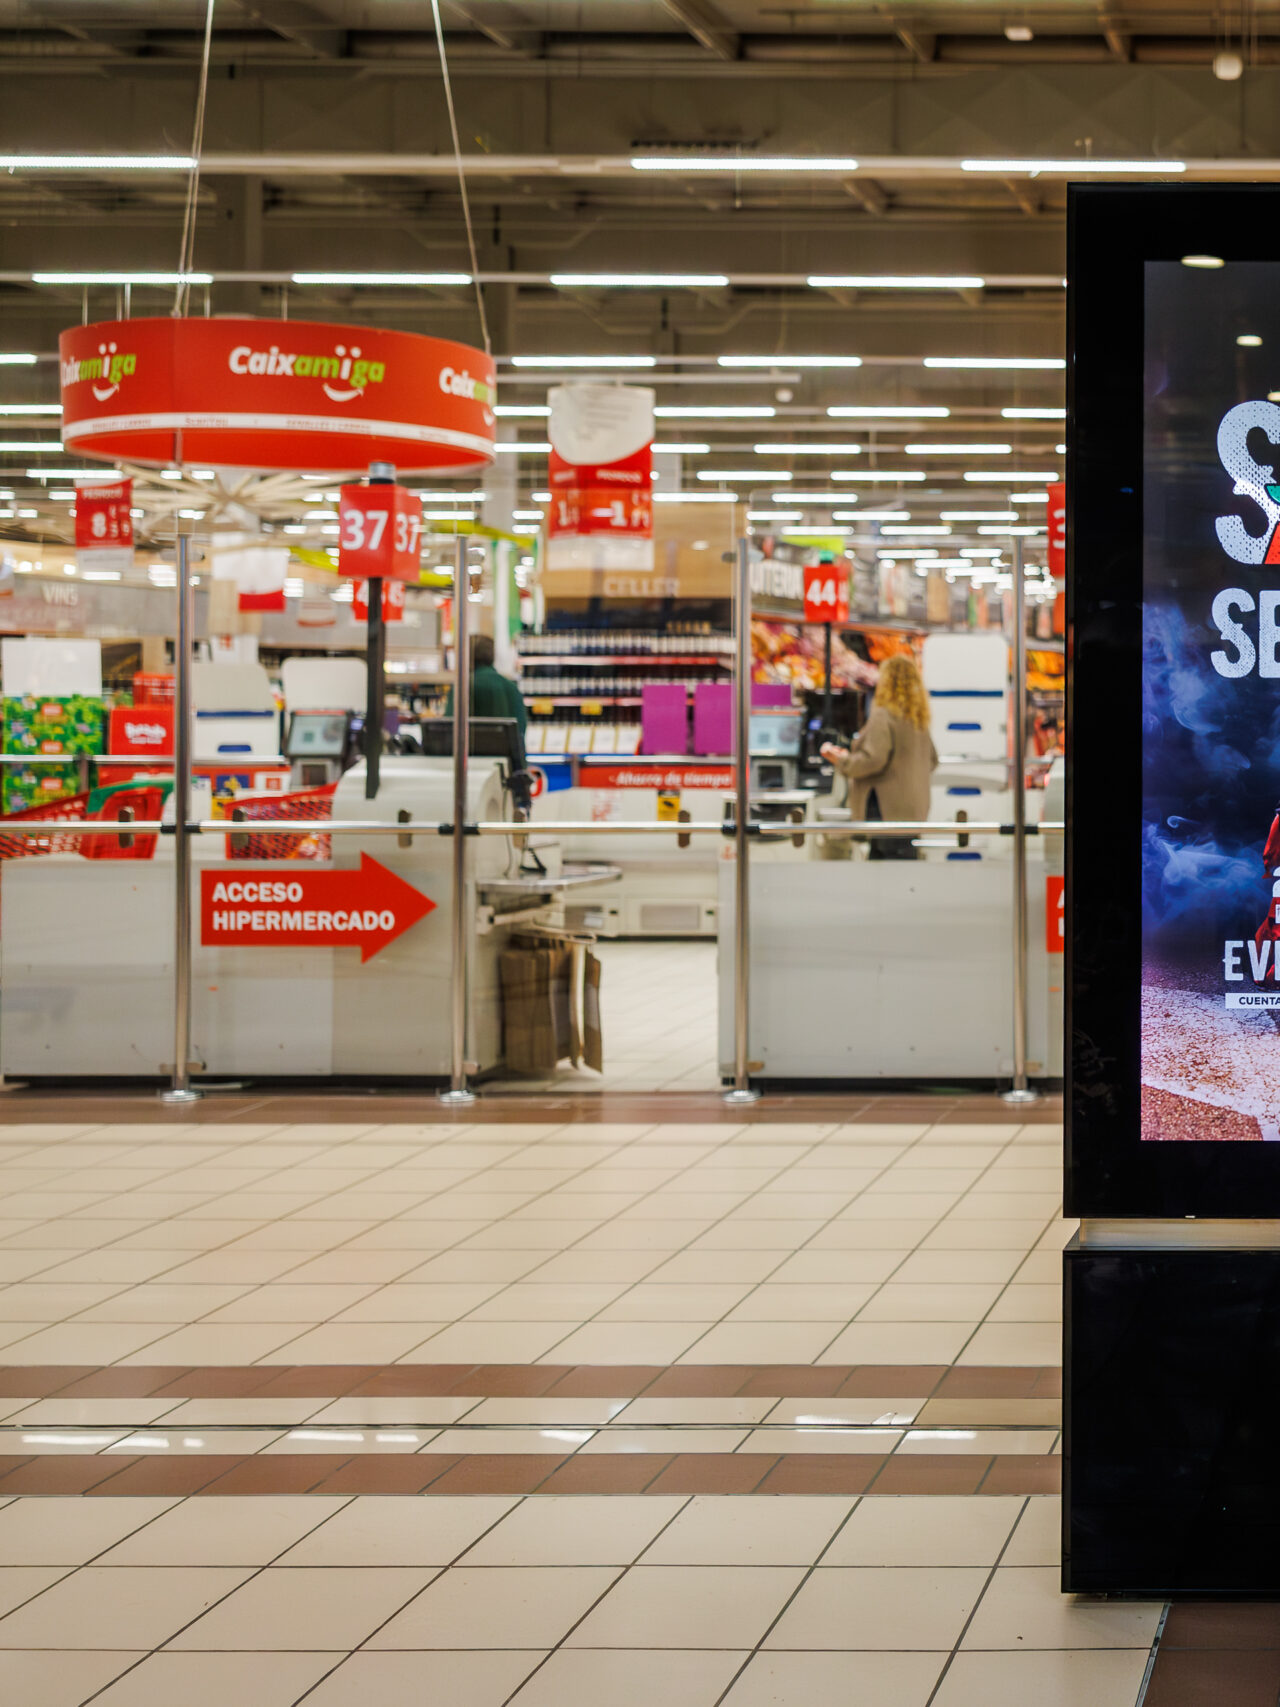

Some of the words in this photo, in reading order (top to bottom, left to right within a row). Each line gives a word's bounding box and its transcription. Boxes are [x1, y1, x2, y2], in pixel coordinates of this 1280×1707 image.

[341, 509, 389, 551] 37
[394, 511, 420, 555] 37
[603, 577, 680, 597] CELLER
[806, 579, 837, 606] 44
[616, 771, 662, 786] Ahorro
[664, 771, 682, 786] de
[684, 771, 732, 789] tiempo
[212, 882, 304, 903] ACCESO
[212, 910, 395, 931] HIPERMERCADO
